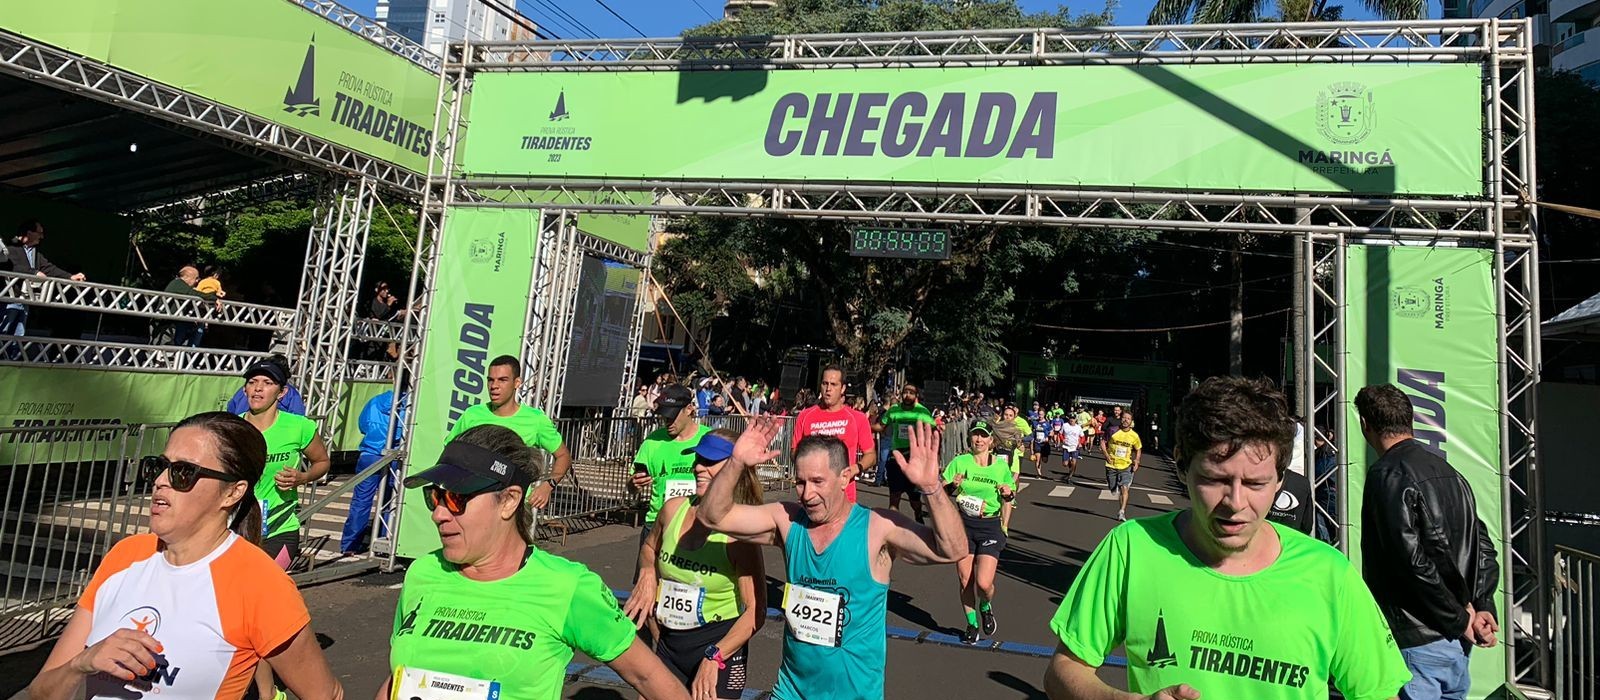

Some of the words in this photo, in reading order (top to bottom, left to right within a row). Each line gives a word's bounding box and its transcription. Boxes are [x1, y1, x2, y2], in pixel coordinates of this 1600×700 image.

[338, 71, 362, 94] PROVA
[331, 91, 433, 157] TIRADENTES
[764, 91, 1057, 158] CHEGADA
[521, 136, 592, 150] TIRADENTES
[1298, 148, 1394, 165] MARINGÁ
[1312, 166, 1379, 175] PREFEITURA
[1432, 277, 1444, 329] MARINGÁ
[447, 302, 494, 432] EGADA
[17, 402, 43, 415] PROVA
[265, 452, 291, 463] ENTES
[670, 488, 694, 496] 2475
[960, 499, 980, 512] 2885
[434, 606, 458, 618] PROVA
[663, 595, 693, 613] 2165
[791, 603, 833, 626] 4922
[421, 619, 536, 650] TIRADENTES
[1191, 629, 1218, 645] PROVA
[1219, 633, 1253, 652] RÚSTICA
[1189, 645, 1309, 688] TIRADENTES
[431, 680, 465, 693] TIRADENTES
